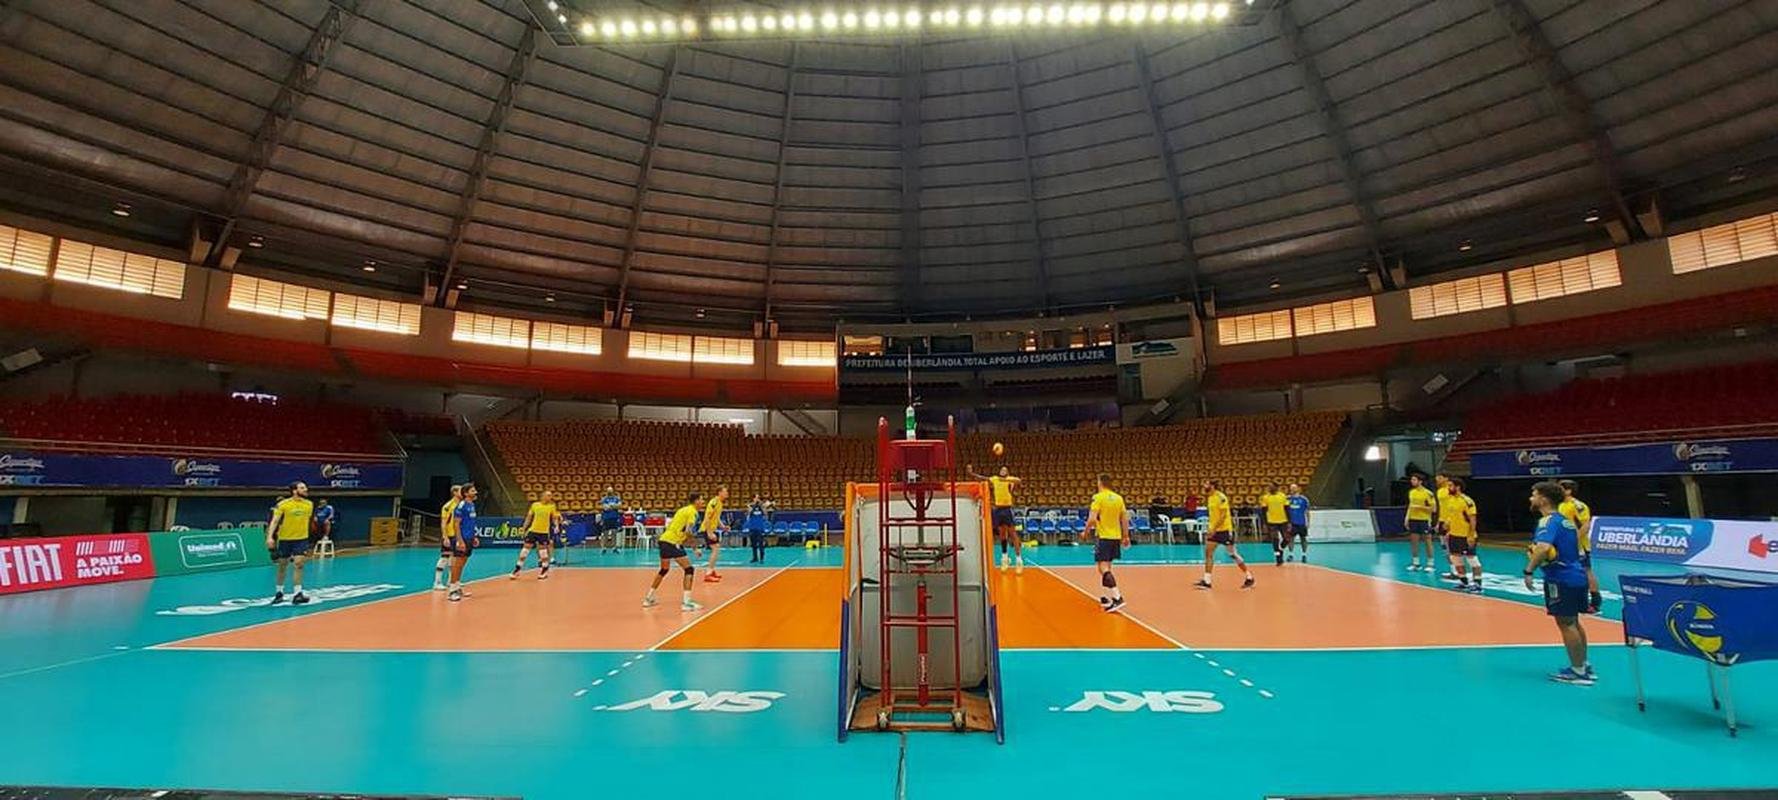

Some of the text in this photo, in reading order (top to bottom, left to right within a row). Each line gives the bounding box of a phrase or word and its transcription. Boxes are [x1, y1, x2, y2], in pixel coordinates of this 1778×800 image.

[845, 358, 895, 368] PREFEITURA
[989, 355, 1015, 365] APOIO
[1017, 354, 1029, 364] AO
[1030, 351, 1068, 363] ESPORTE
[0, 543, 62, 586] FIAT
[76, 552, 143, 568] A PAIXÃO
[77, 565, 124, 578] MOVE.
[1063, 690, 1224, 712] SKY
